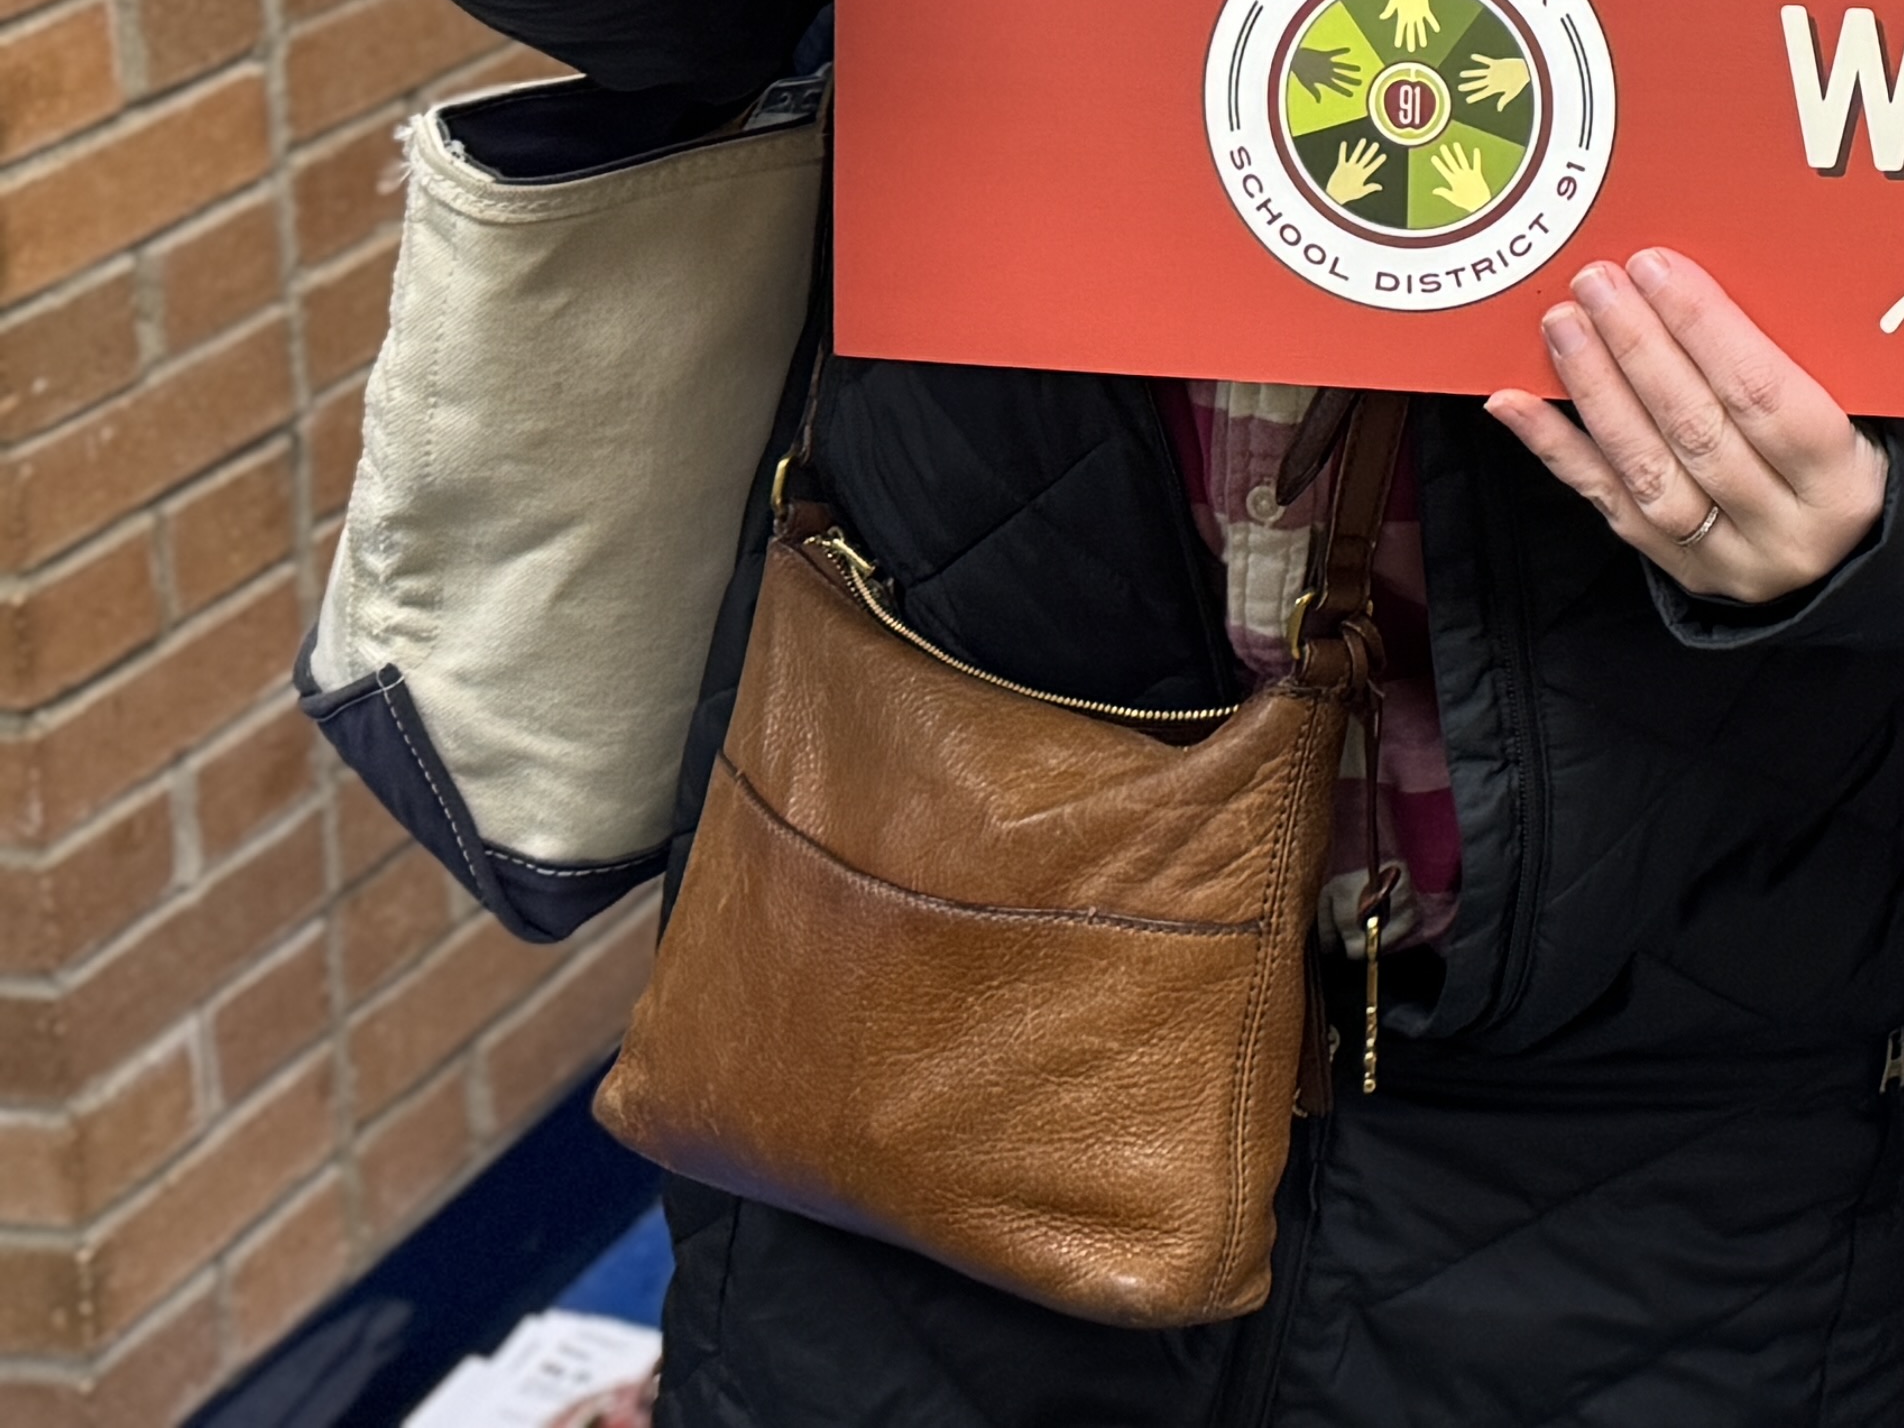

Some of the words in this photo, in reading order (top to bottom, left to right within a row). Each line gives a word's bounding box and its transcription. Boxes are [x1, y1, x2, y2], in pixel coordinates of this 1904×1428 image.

[1398, 84, 1422, 126] 91
[1229, 145, 1350, 281] SCHOOL
[1374, 212, 1551, 295] DISTRICT
[1555, 161, 1587, 202] 91
